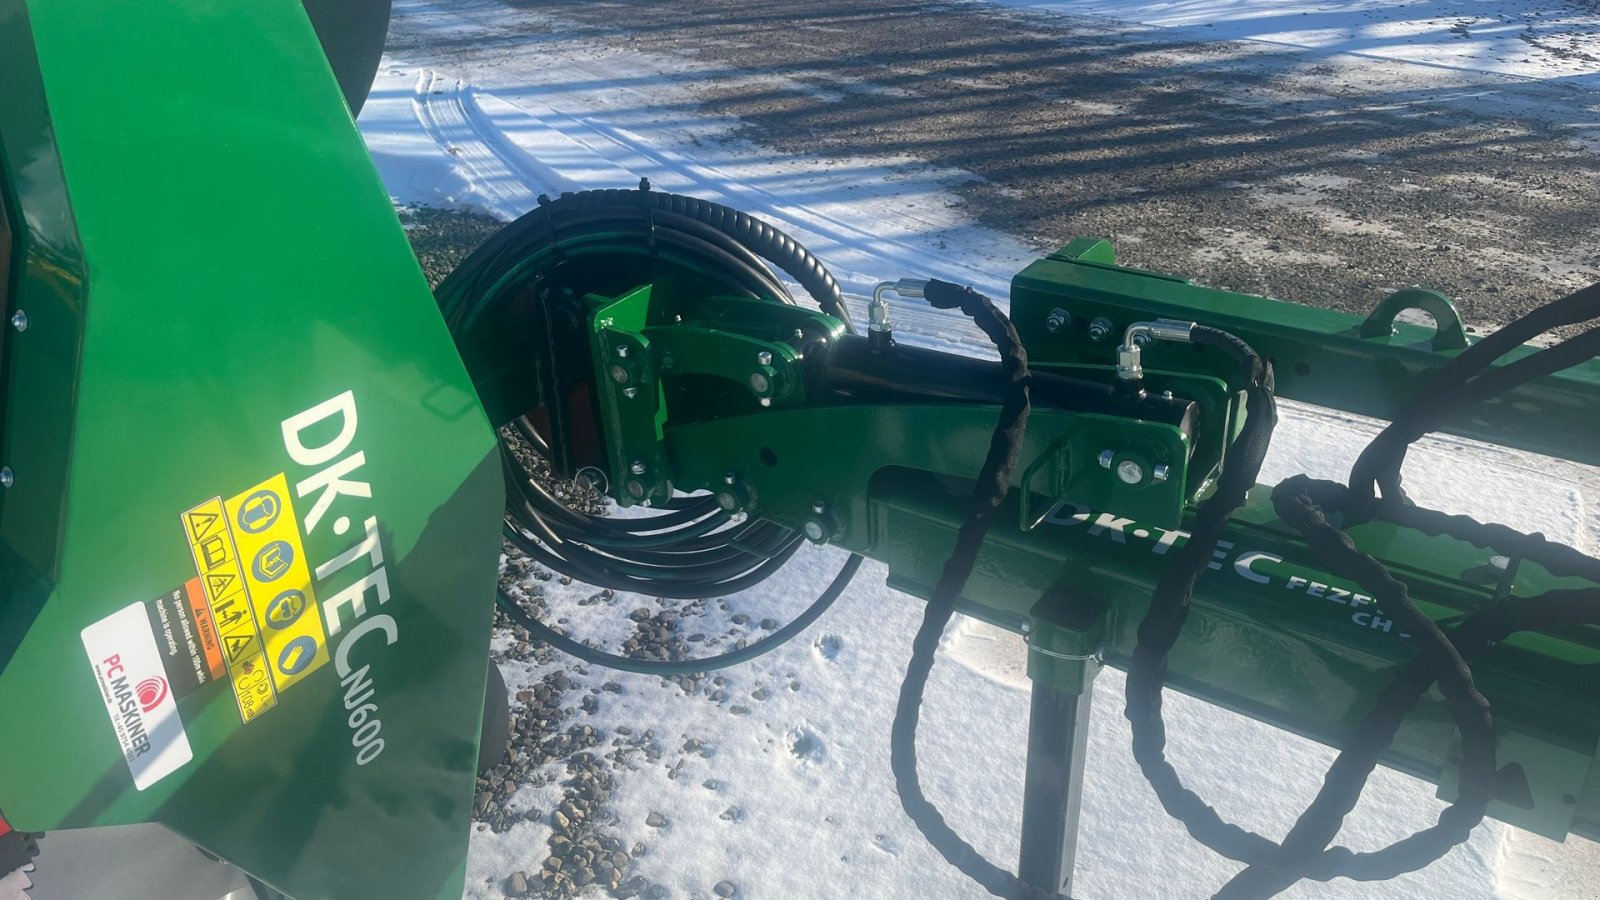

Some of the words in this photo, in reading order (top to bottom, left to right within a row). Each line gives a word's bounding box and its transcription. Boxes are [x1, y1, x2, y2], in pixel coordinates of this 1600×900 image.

[172, 589, 181, 600] No
[155, 598, 168, 622] machine
[173, 599, 186, 620] person
[180, 618, 193, 641] allowed
[200, 618, 215, 651] WARNING
[187, 638, 198, 657] within
[103, 653, 124, 679] PC
[110, 675, 151, 758] MASKINER
[340, 663, 385, 766] NJ600
